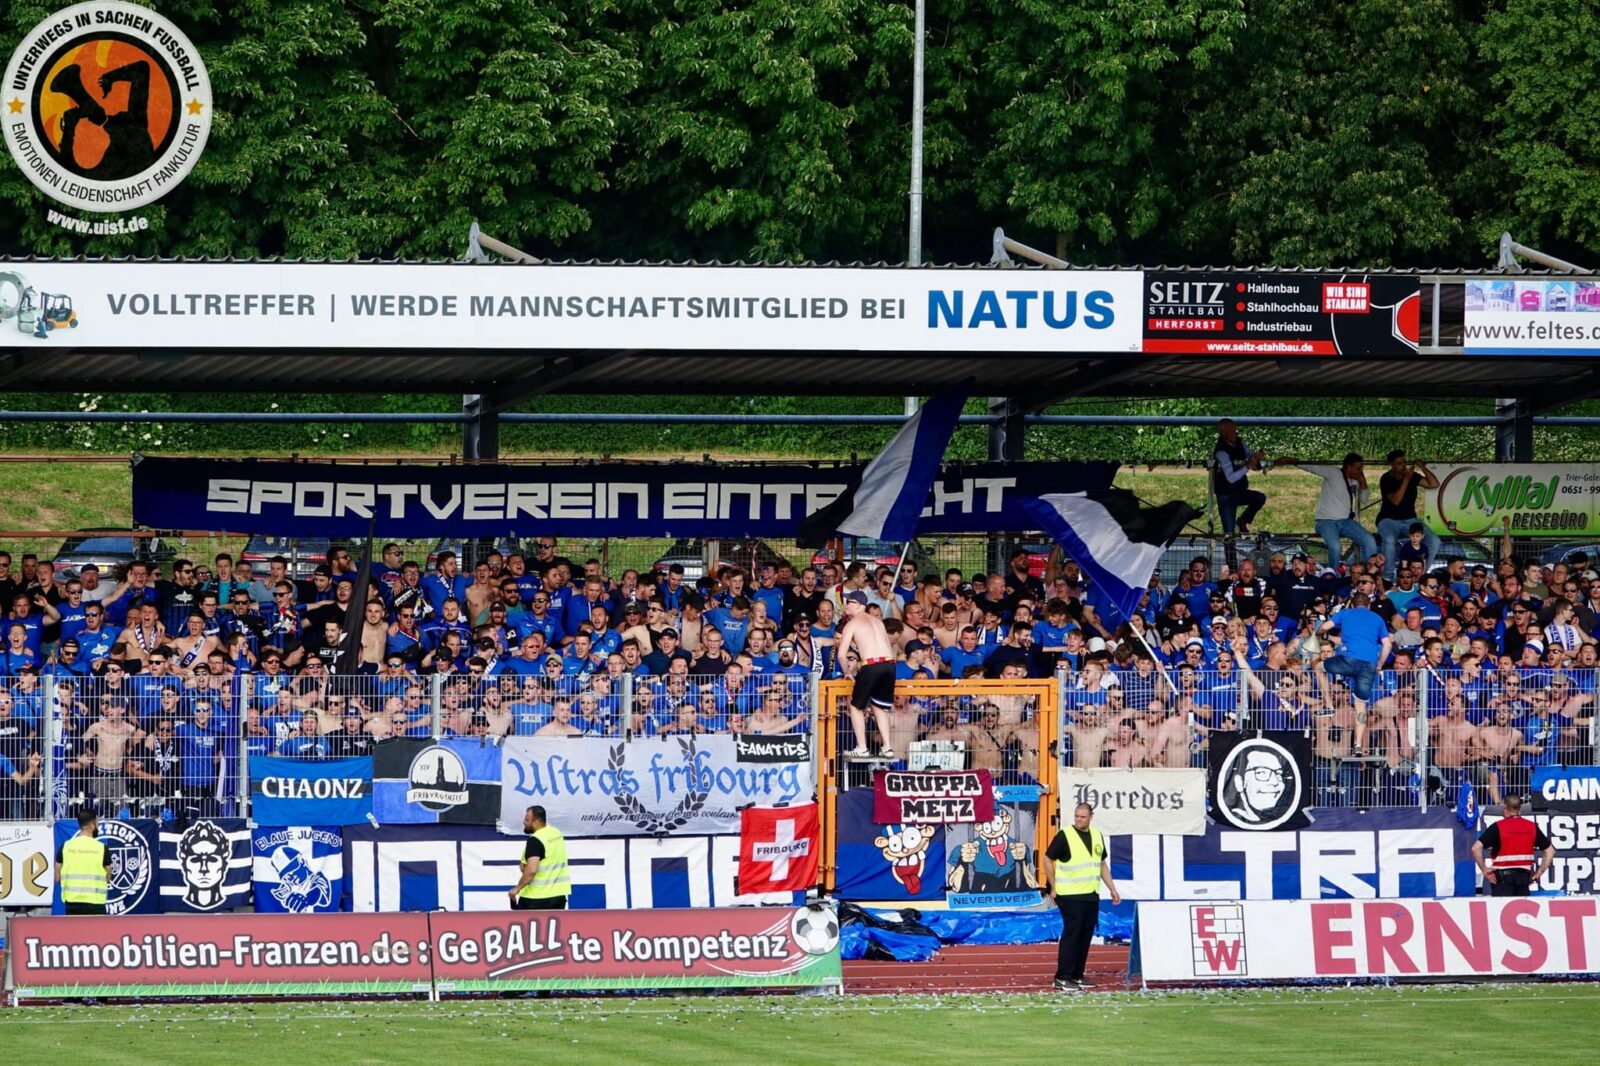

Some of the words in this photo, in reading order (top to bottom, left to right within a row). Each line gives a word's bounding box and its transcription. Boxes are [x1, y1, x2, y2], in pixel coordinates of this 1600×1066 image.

[1150, 281, 1225, 304] SEITZ
[1247, 283, 1300, 293] Hallenbau
[1326, 286, 1344, 298] WIR
[1346, 286, 1367, 298] SIND
[107, 293, 315, 316] VOLLTREFFER
[351, 295, 458, 317] WERDE
[469, 296, 849, 320] MANNSCHAFTSMITGLIED
[861, 298, 906, 320] BEI
[928, 289, 1115, 330] NATUS
[1149, 306, 1225, 316] STAHLBAU
[1246, 302, 1319, 313] Stahlhochbau
[1325, 298, 1367, 310] STAHLBAU
[1155, 320, 1217, 329] HERFORST
[1246, 321, 1313, 332] Industriebau
[1207, 342, 1314, 352] www.seitz-stahlbau.de
[206, 478, 648, 520] SPORTVEREIN
[663, 477, 1017, 520] EINTRHT
[1460, 474, 1560, 517] Kylltal
[1561, 486, 1583, 494] 0651
[1512, 509, 1588, 530] REISEBÜRO
[261, 776, 364, 799] CHAONZ
[886, 773, 982, 796] GRUPPA
[901, 798, 975, 822] METZ
[256, 830, 294, 851] BLAUE
[297, 830, 340, 848] JUGEND
[756, 841, 808, 855] FRIBOURG
[1100, 829, 1455, 900] ULTRA
[953, 896, 993, 905] NEVER
[994, 895, 1021, 904] GIVE
[1310, 899, 1597, 975] ERNST
[26, 933, 410, 968] Immobilien-Franzen.de
[613, 929, 788, 967] Kompetenz
